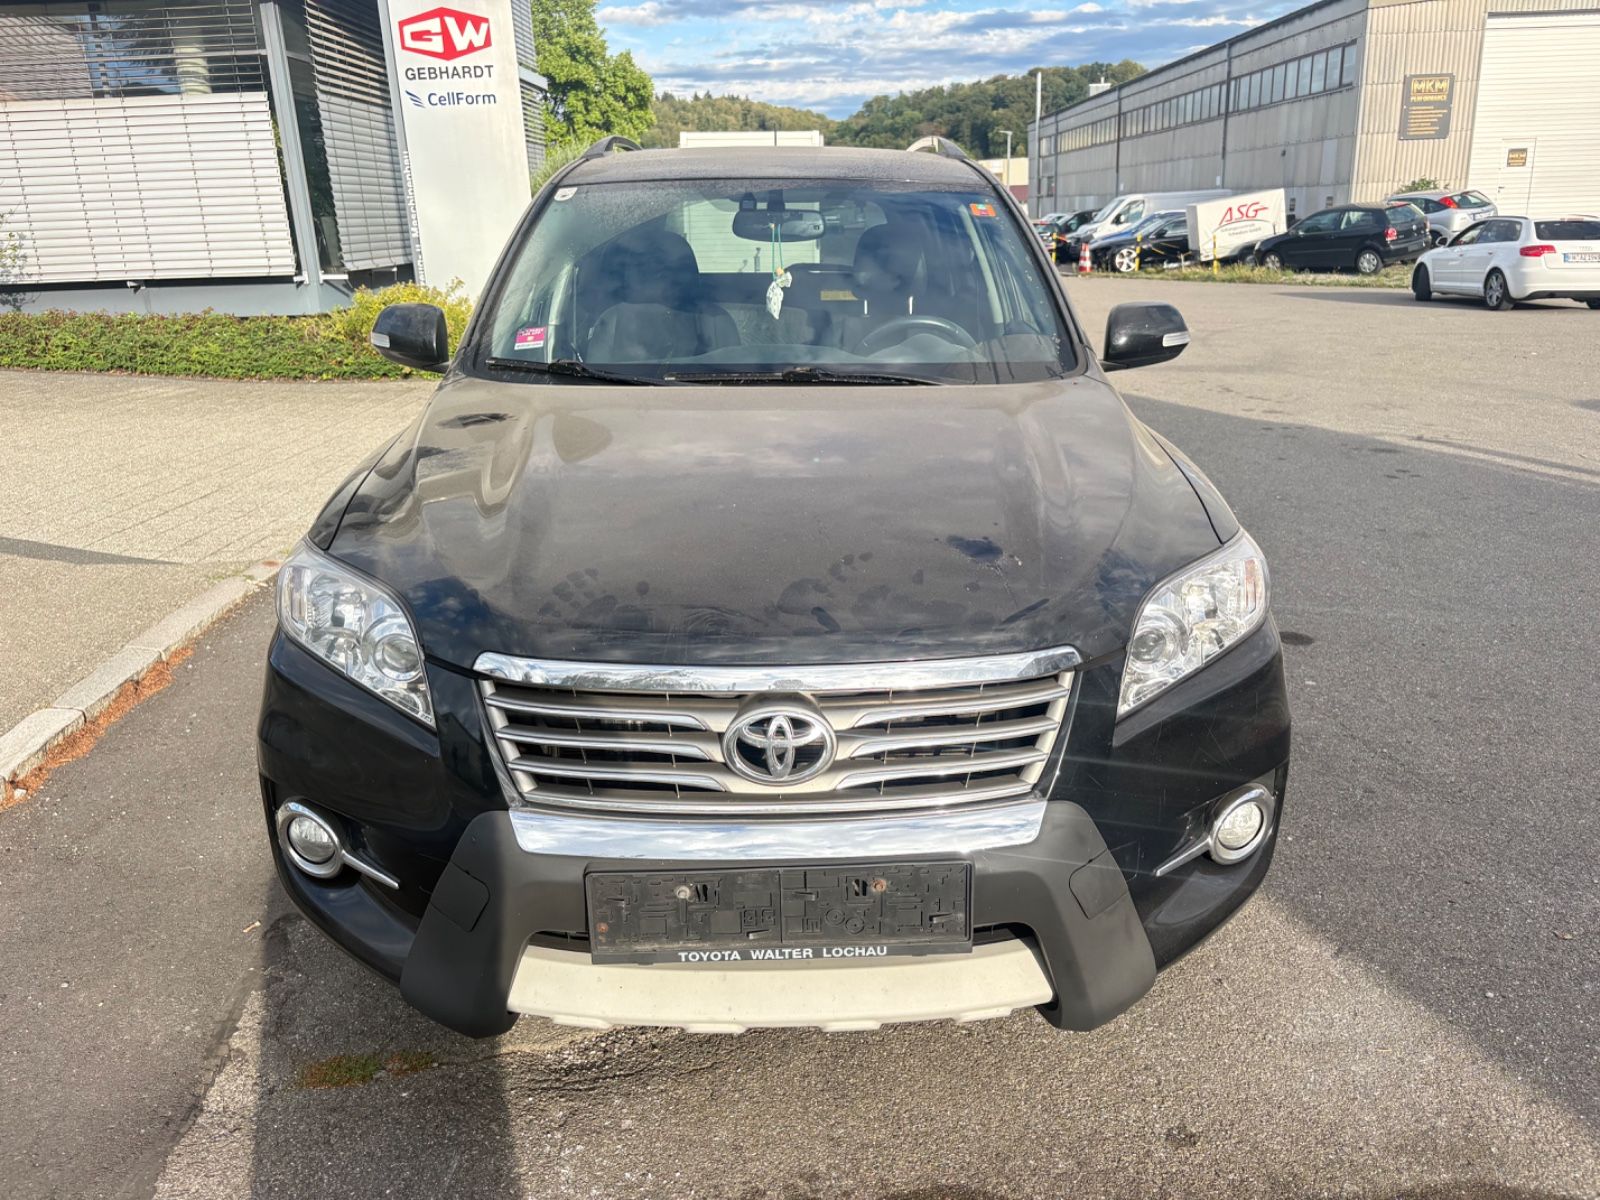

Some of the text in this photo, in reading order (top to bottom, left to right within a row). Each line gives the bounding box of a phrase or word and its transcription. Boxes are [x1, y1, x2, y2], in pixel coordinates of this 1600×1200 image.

[403, 16, 489, 54] GW
[405, 65, 494, 80] GEBHARDT
[1412, 79, 1448, 93] MKM
[428, 92, 497, 106] CellForm
[1219, 202, 1269, 225] ASG
[678, 946, 888, 962] TOYOTA WALTER LOCHAU
